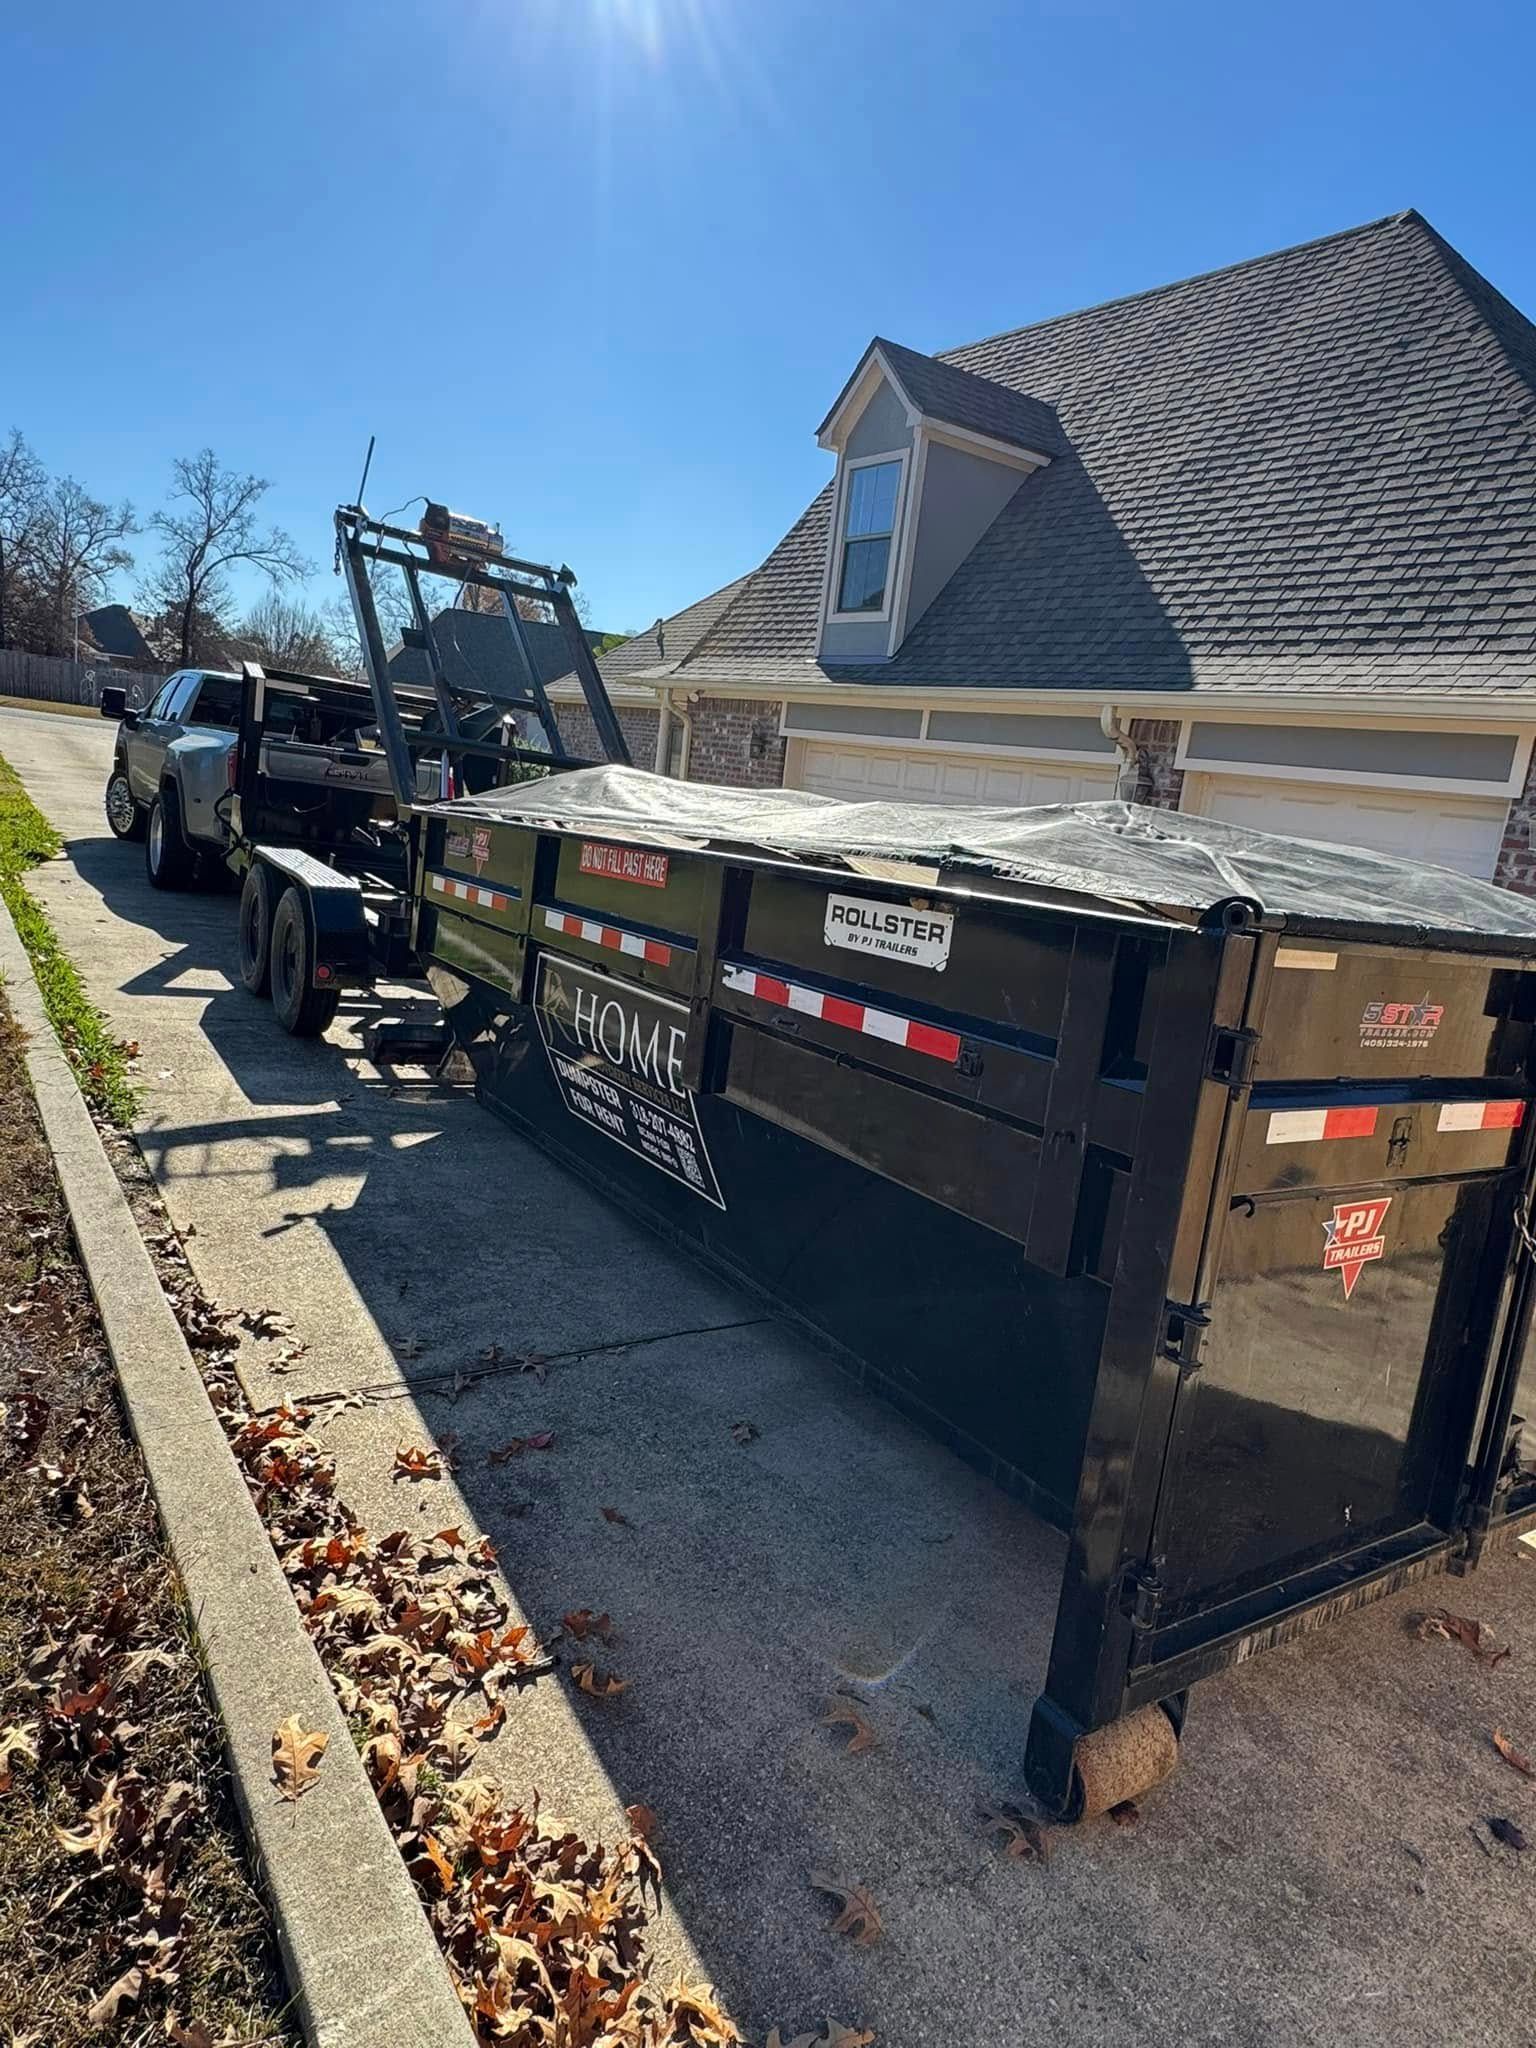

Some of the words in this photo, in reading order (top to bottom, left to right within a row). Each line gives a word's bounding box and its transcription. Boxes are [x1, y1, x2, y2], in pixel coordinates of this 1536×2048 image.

[582, 845, 593, 867] DO
[592, 847, 608, 870] NOT
[607, 849, 621, 873] FILL
[622, 851, 645, 877] PAST
[644, 855, 667, 882] HERE
[831, 904, 946, 944] ROLLSTER
[847, 933, 860, 943] BY
[861, 936, 873, 947] PJ
[874, 938, 918, 956] TRAILERS
[574, 987, 687, 1098] HOME
[556, 1057, 624, 1110] DUMPSTER
[569, 1088, 597, 1117] FOR
[593, 1102, 627, 1136] RENT
[1344, 1208, 1377, 1238] PJ
[1329, 1241, 1381, 1262] TRAILERS
